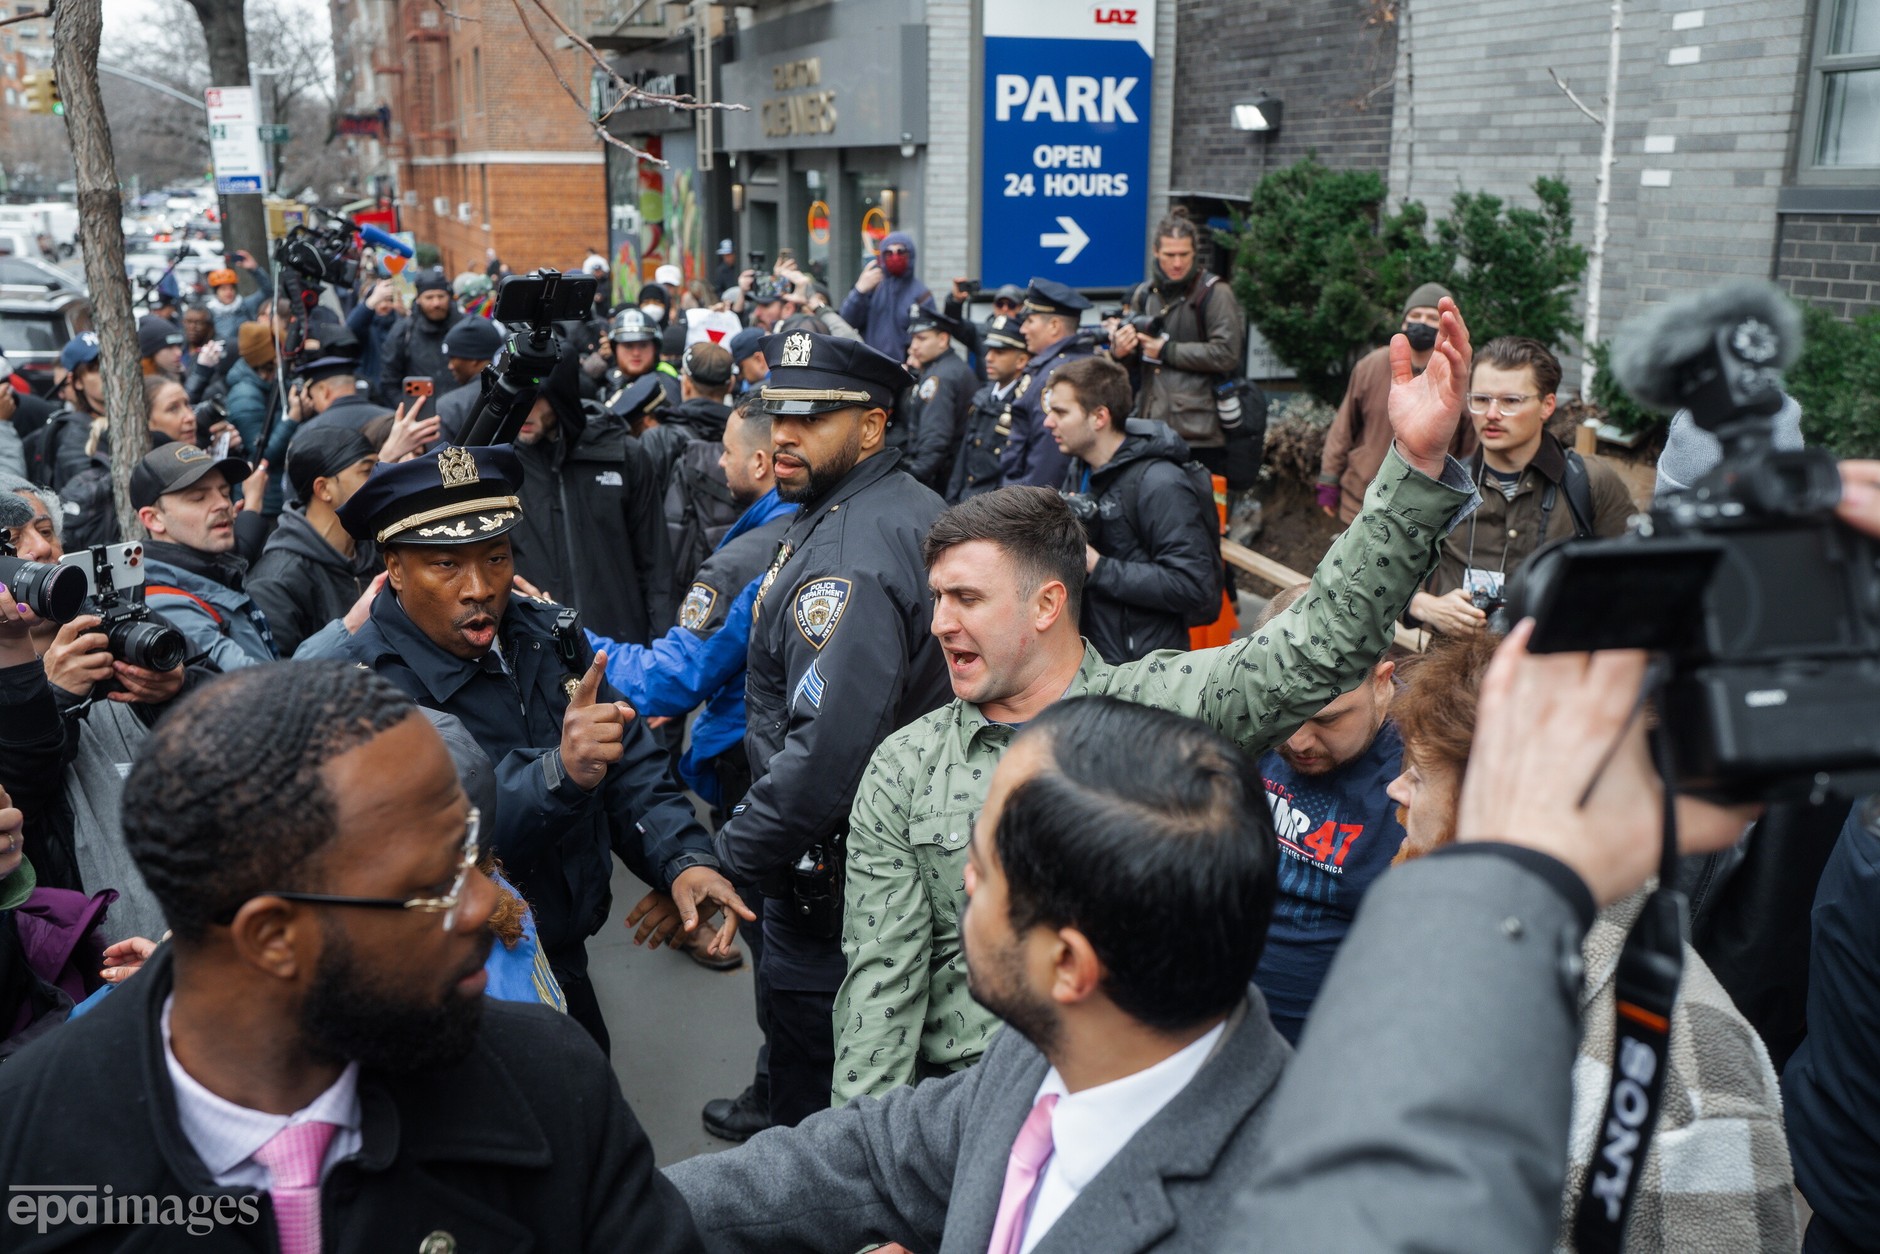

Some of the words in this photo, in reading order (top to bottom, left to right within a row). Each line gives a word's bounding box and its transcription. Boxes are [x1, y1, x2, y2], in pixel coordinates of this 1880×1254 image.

[1094, 8, 1138, 25] LAZ
[996, 74, 1139, 123] PARK
[1033, 144, 1101, 169] OPEN
[1004, 173, 1035, 197] 24
[1044, 173, 1129, 197] HOURS
[800, 589, 844, 602] DEPARTMENT
[810, 582, 835, 591] POLICE
[797, 610, 806, 626] CITY
[804, 627, 813, 637] OF
[821, 622, 833, 638] NEW
[830, 602, 844, 621] YORK
[1303, 820, 1364, 866] 47
[1282, 846, 1300, 860] STATES
[1301, 856, 1309, 864] OF
[1310, 860, 1343, 874] AMERICA
[1592, 1035, 1658, 1222] SONY
